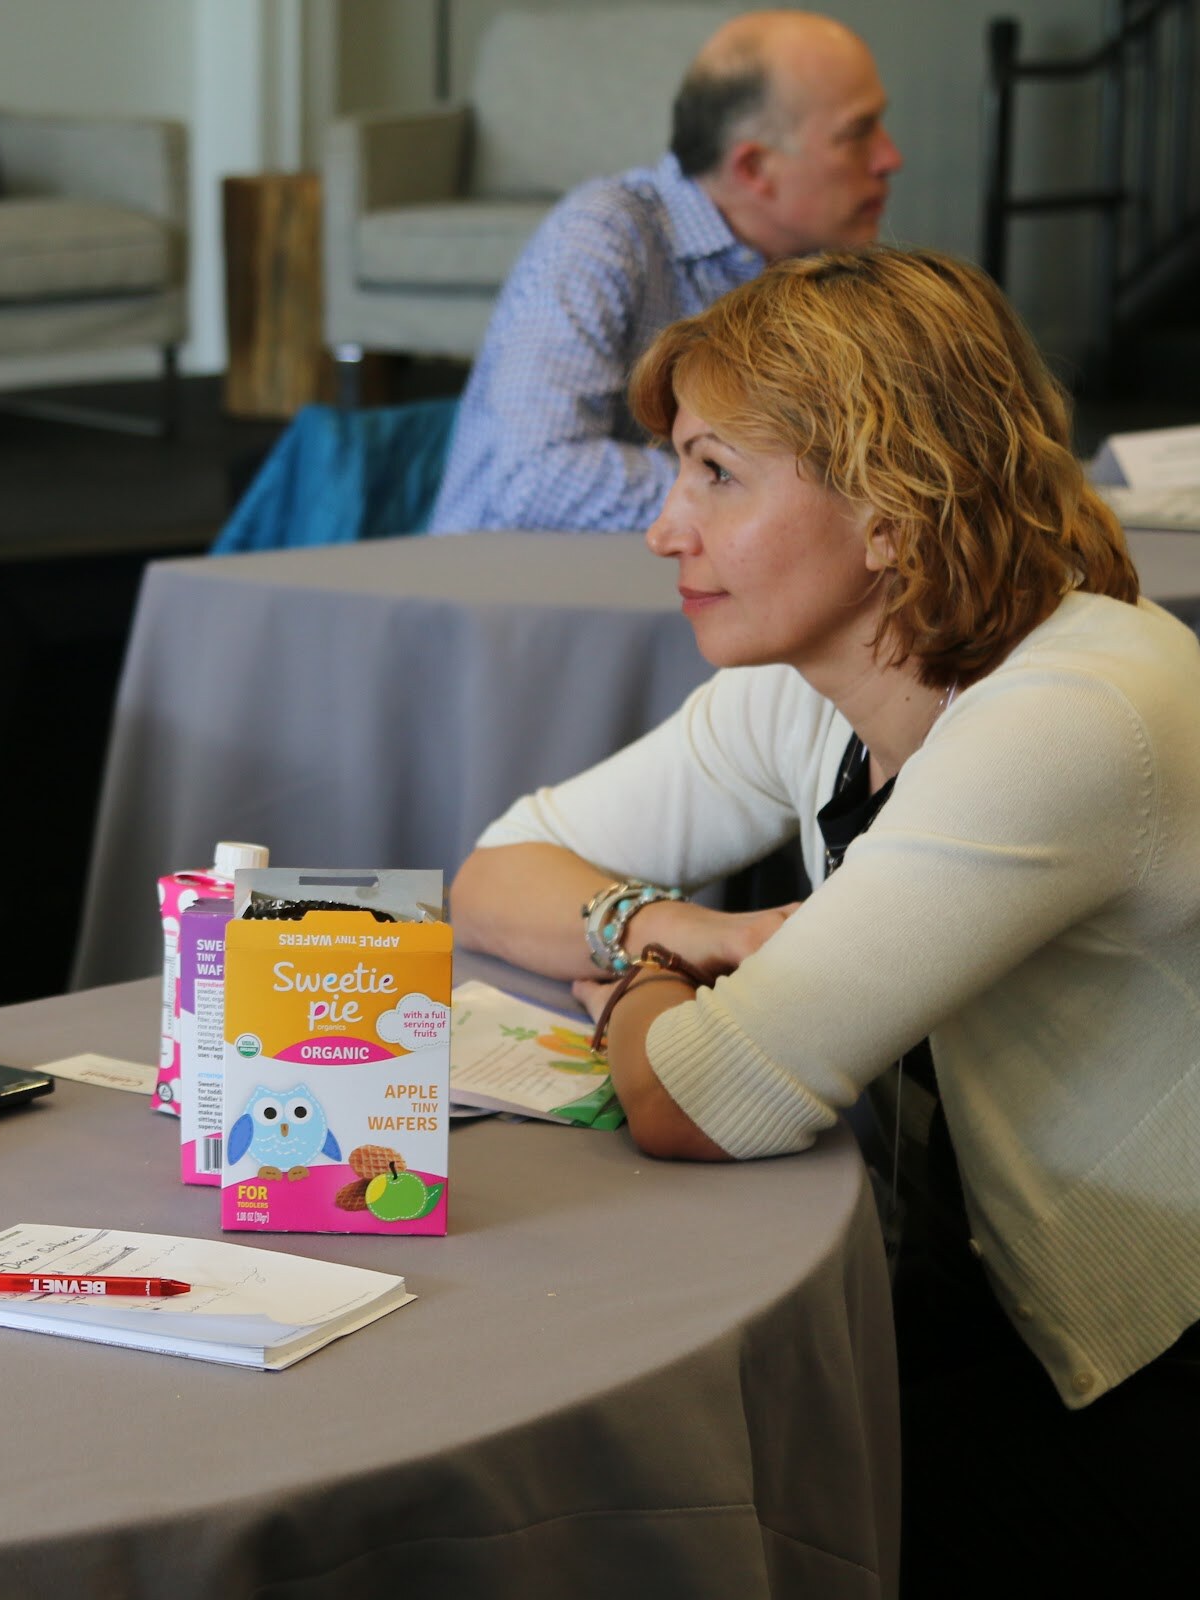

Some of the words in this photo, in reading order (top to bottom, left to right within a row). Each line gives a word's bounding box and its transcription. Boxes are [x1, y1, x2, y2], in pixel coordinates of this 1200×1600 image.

[279, 934, 333, 946] WAFERS
[334, 936, 357, 945] TINY
[359, 935, 400, 948] APPLE
[197, 953, 216, 962] TINY
[197, 963, 224, 976] WAF
[273, 962, 398, 994] Sweetie
[307, 994, 363, 1032] pie
[403, 1011, 423, 1019] with
[431, 1011, 446, 1019] full
[318, 1024, 347, 1032] organics
[403, 1021, 435, 1030] serving
[414, 1030, 438, 1038] fruits
[301, 1046, 370, 1060] ORGANIC
[385, 1085, 438, 1099] APPLE
[411, 1103, 438, 1113] TINY
[368, 1116, 438, 1132] WAFERS
[238, 1185, 268, 1200] FOR
